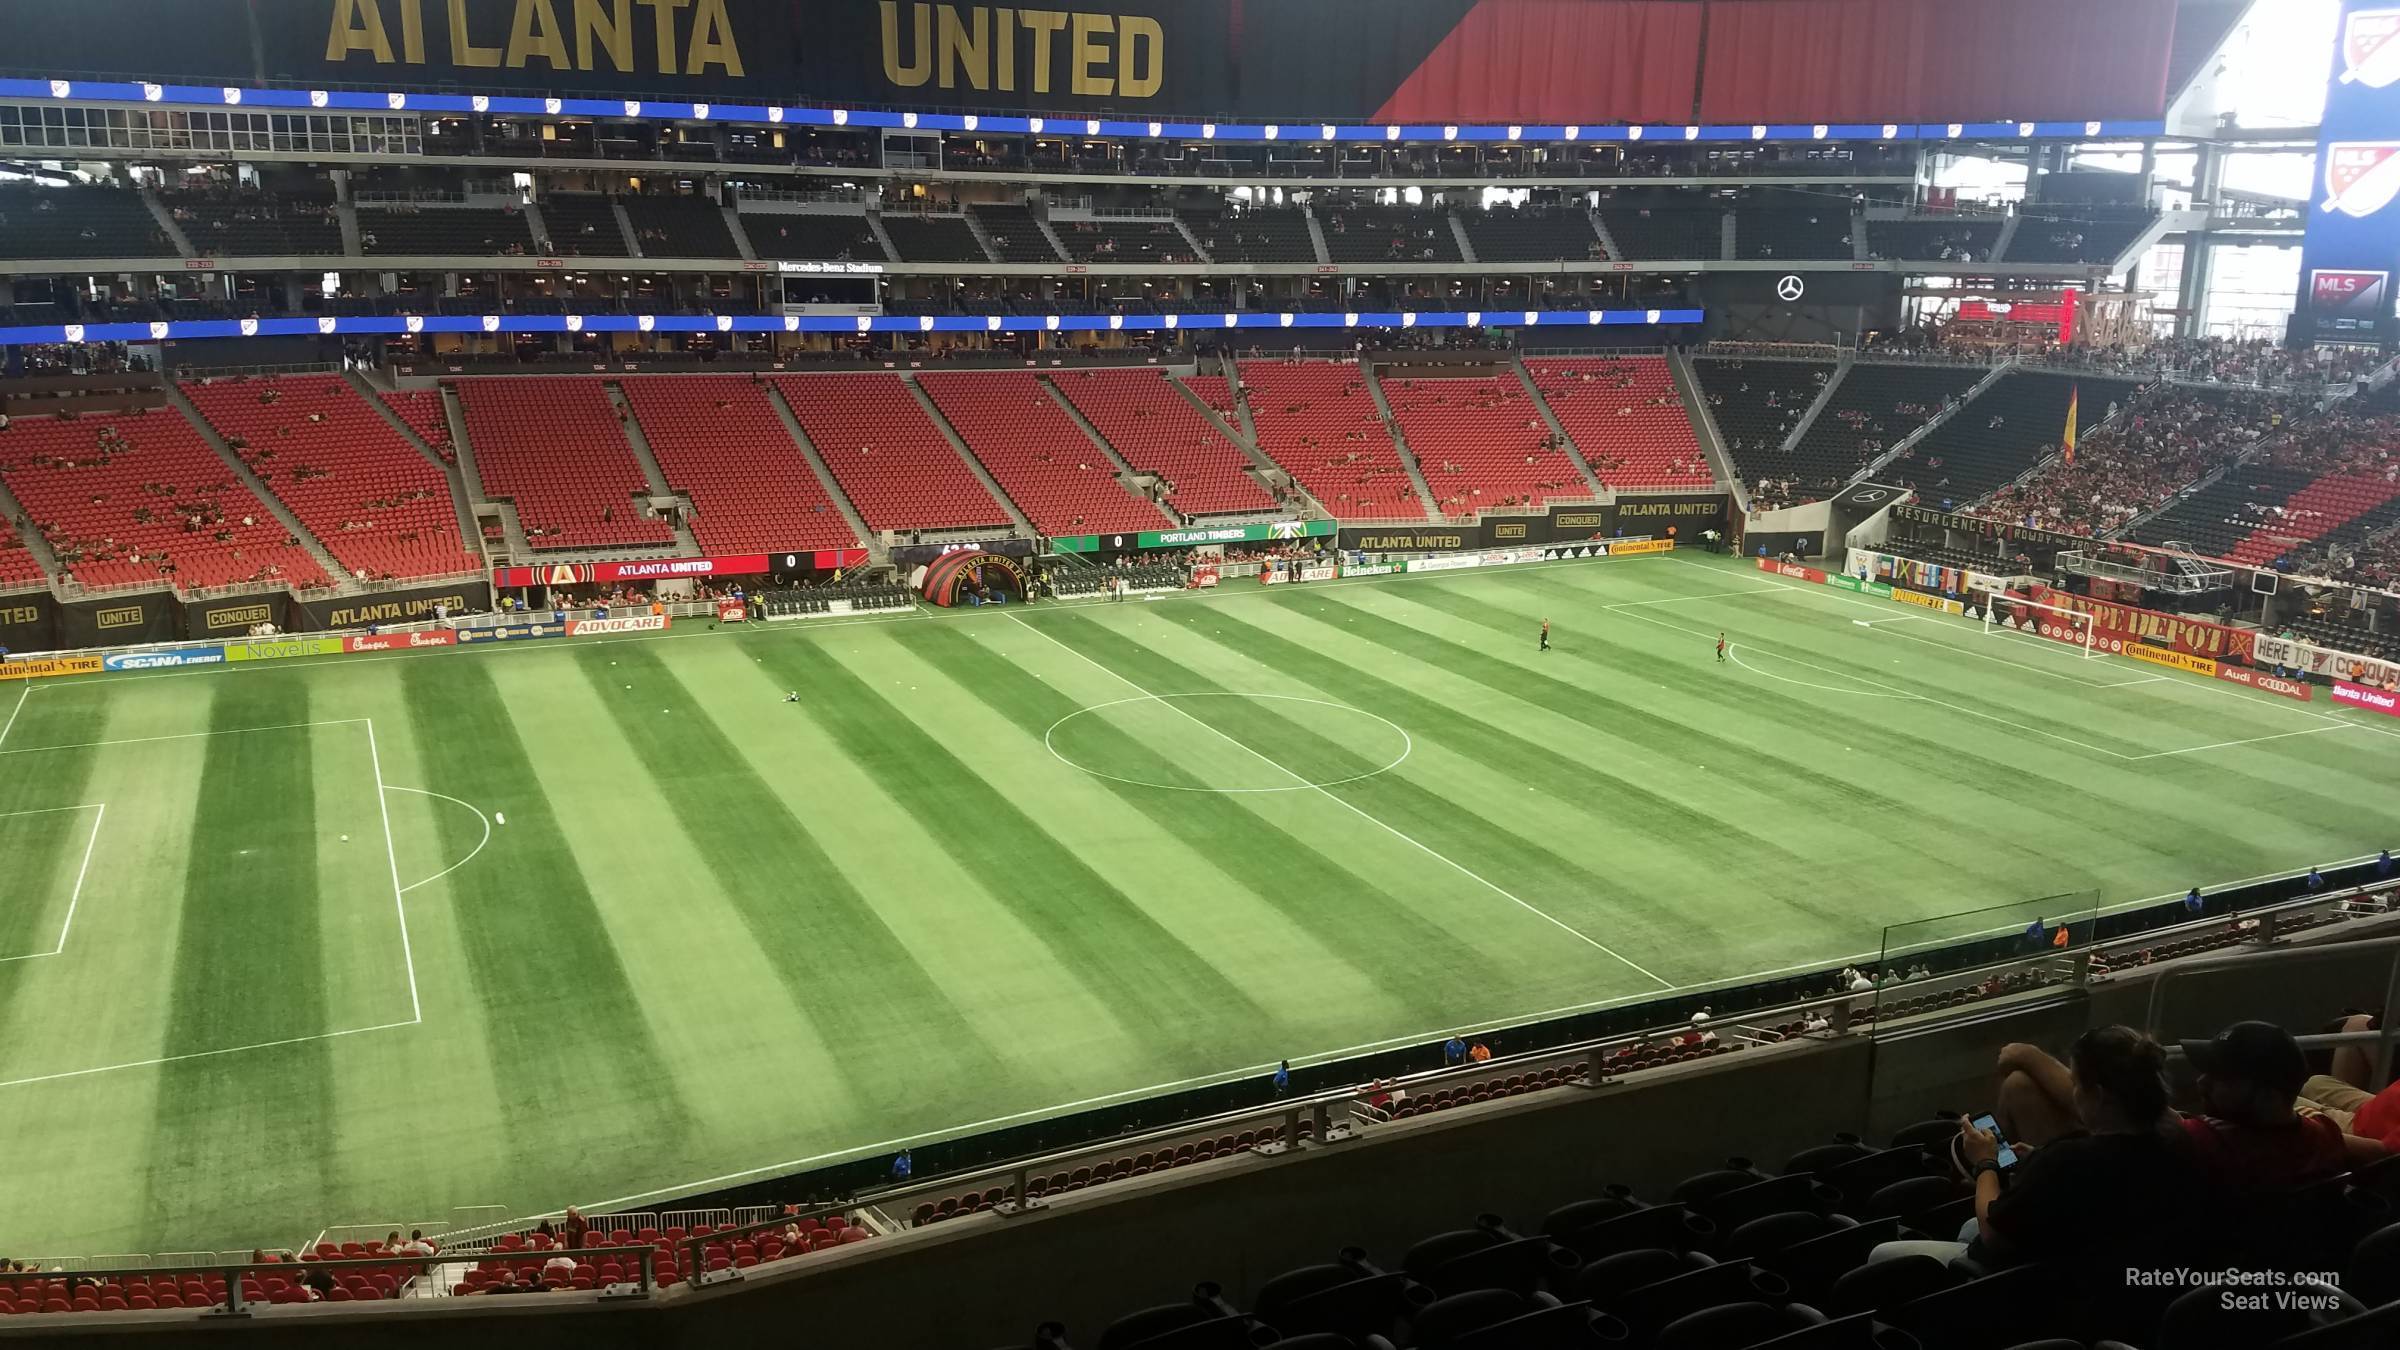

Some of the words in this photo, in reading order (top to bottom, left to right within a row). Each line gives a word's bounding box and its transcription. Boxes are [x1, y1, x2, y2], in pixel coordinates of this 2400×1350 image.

[325, 0, 745, 76] ATLANTA
[879, 0, 1164, 97] UNITED
[778, 261, 845, 272] Mercedes-Benz
[847, 263, 883, 273] Stadium
[2318, 277, 2356, 293] MLS
[1619, 503, 1671, 516] ATLANTA
[1674, 503, 1718, 516] UNITED
[1559, 516, 1598, 525] CONQUER
[1897, 507, 1985, 533] RESURGENCE
[1160, 531, 1206, 543] PORTLAND
[1207, 529, 1246, 540] TIMBERS
[1498, 526, 1524, 536] UNITE
[2014, 527, 2051, 545] ROWDY
[1114, 535, 1122, 547] 0
[1359, 536, 1413, 549] ATLANTA
[1416, 536, 1461, 548] UNITED
[1611, 541, 1651, 554] Continental
[618, 563, 669, 575] ATLANTA
[671, 561, 713, 572] UNITED
[786, 554, 796, 567] 0
[1271, 568, 1332, 582] ADCARE
[1343, 564, 1391, 577] Heineken
[1893, 587, 1944, 610] QUIKRETE
[0, 606, 38, 625] TED
[101, 610, 139, 625] UNITE
[210, 607, 267, 626] CONQUER
[330, 602, 402, 626] ATLANTA
[574, 616, 665, 635] ADVOCARE
[2128, 611, 2226, 652] DEPOT
[246, 640, 321, 659] Novelis
[71, 660, 98, 670] TIRE
[121, 655, 183, 669] SCANA
[186, 654, 223, 664] ENERGY
[2126, 643, 2180, 665] Continental
[2191, 660, 2213, 673] TIRE
[2257, 639, 2290, 661] HERE
[2295, 644, 2310, 665] TO
[2335, 656, 2400, 688] COQUE
[2224, 668, 2250, 682] Audi
[2362, 693, 2395, 708] United
